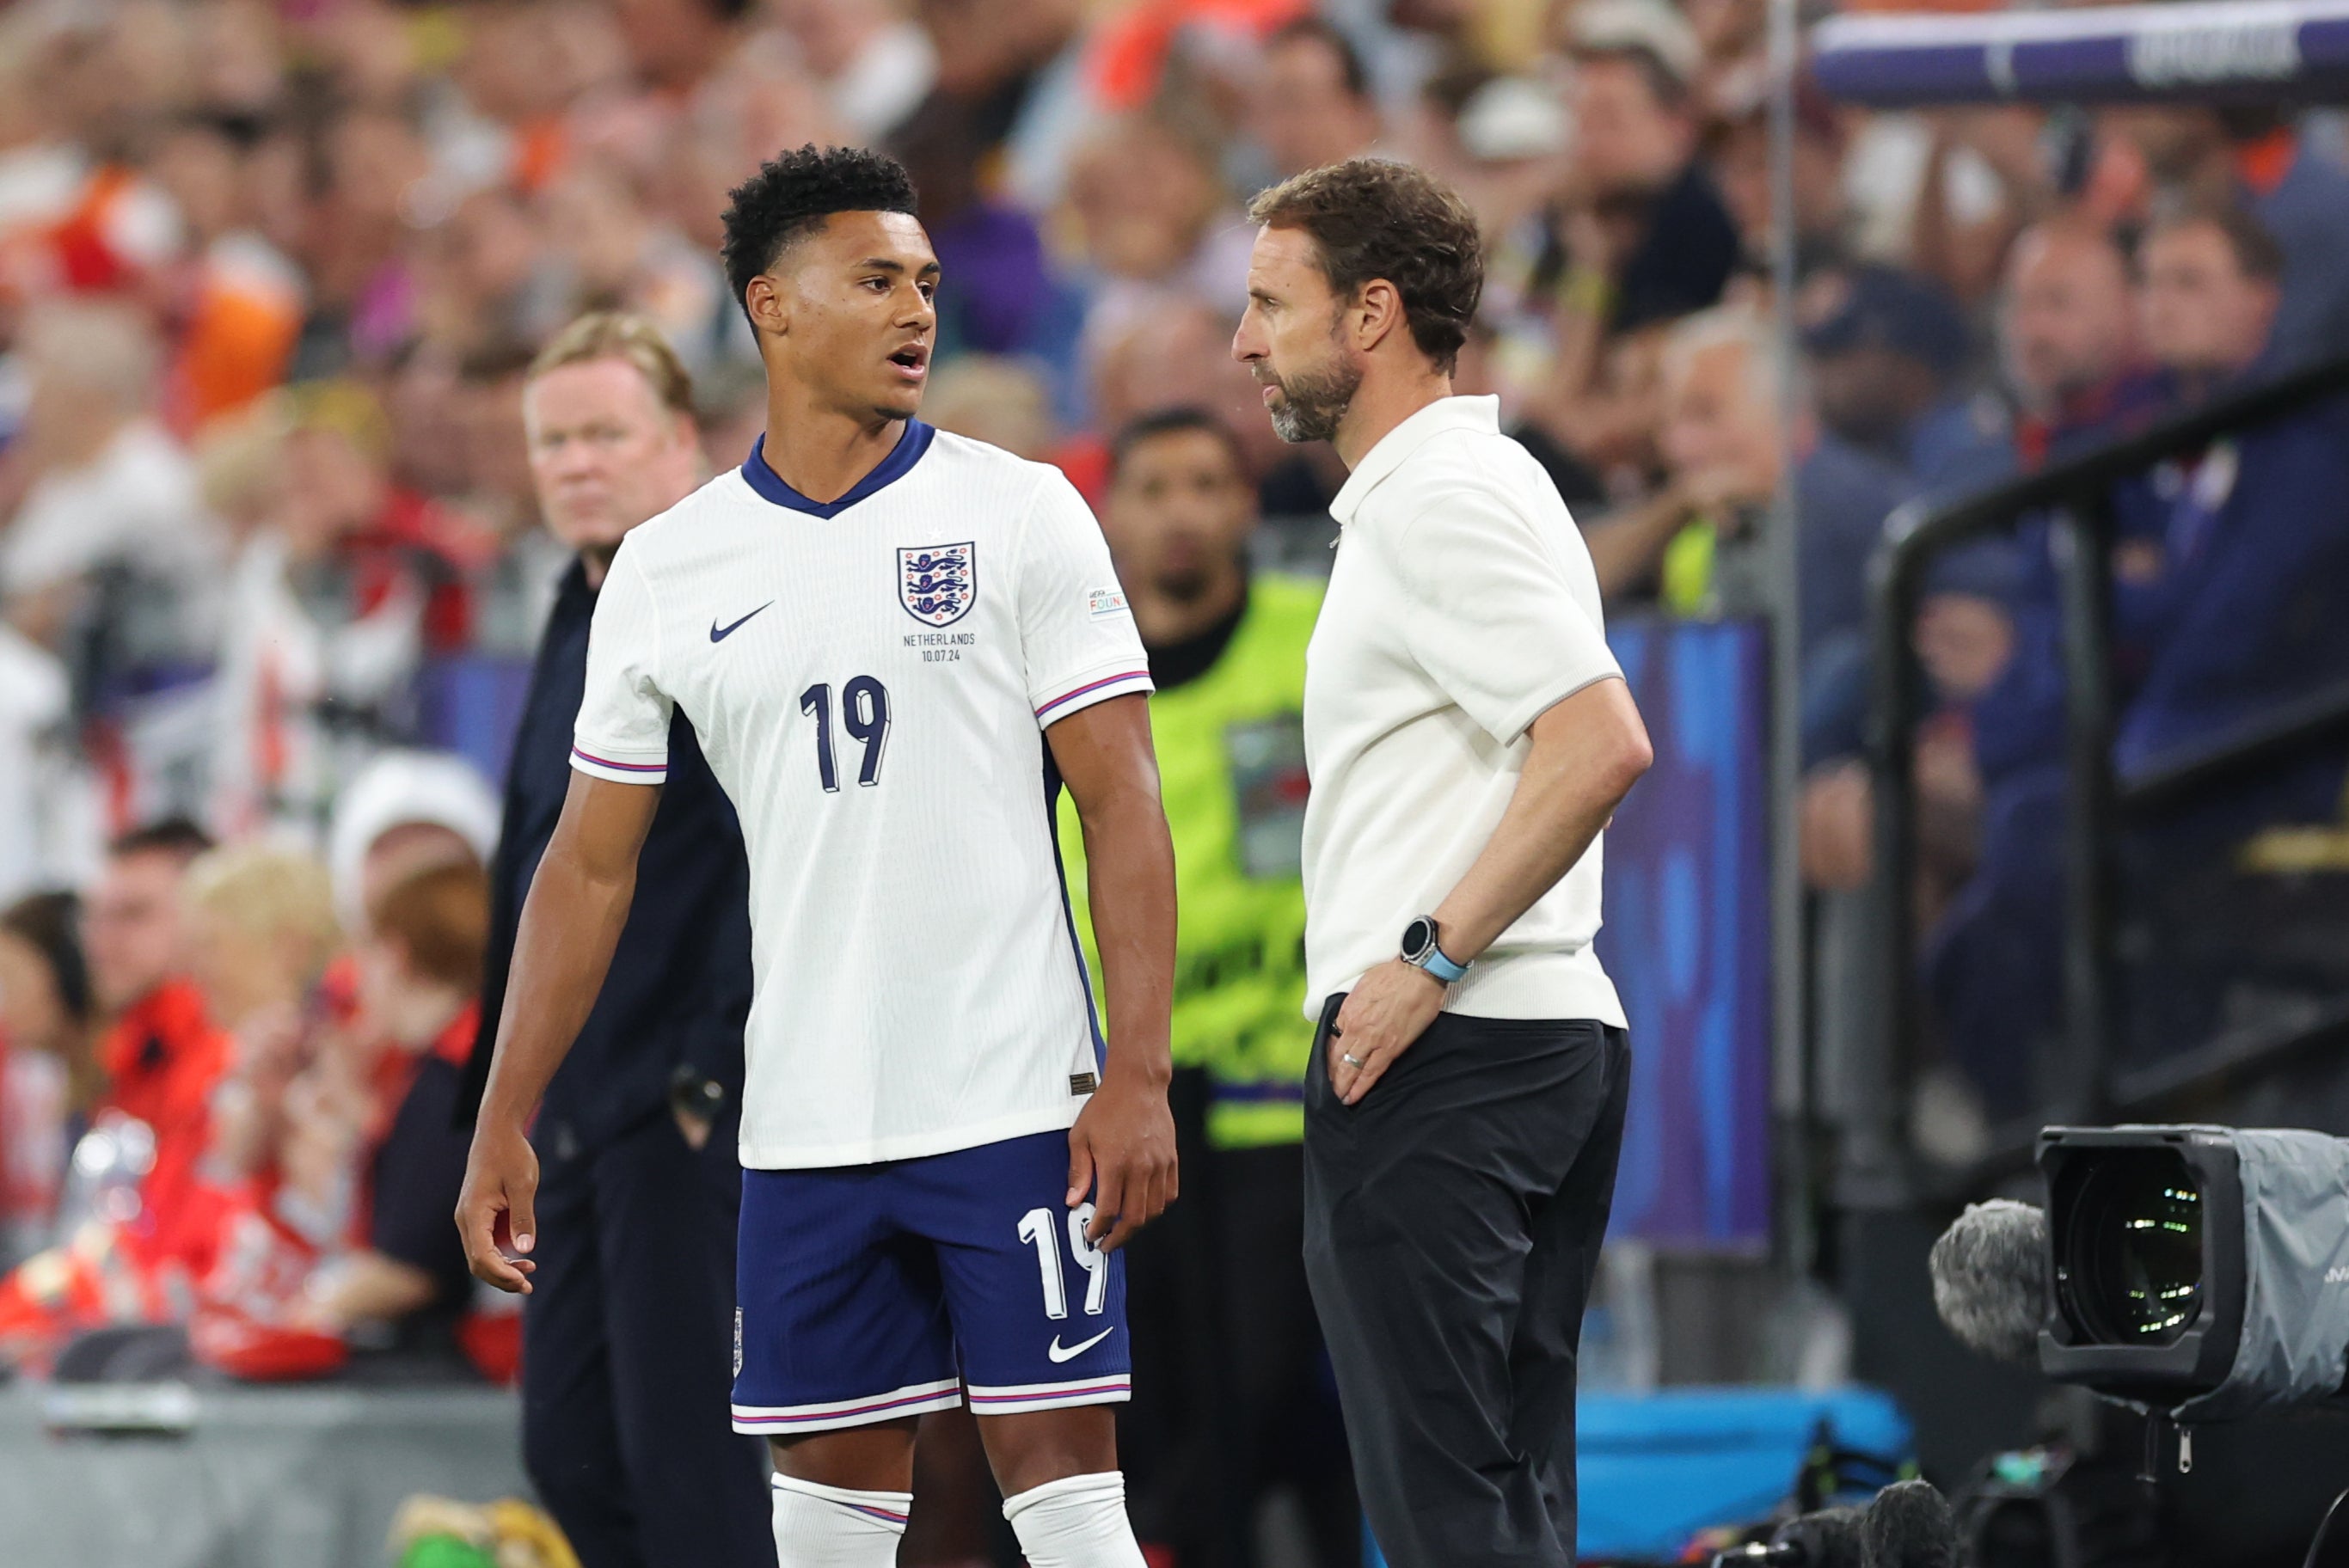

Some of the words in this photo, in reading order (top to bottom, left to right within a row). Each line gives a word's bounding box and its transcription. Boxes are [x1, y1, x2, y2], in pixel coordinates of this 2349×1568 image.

[904, 634, 975, 646] NETHERLANDS
[922, 649, 960, 662] 10.07.24
[800, 675, 892, 793] 19
[1017, 1202, 1108, 1320] 19
